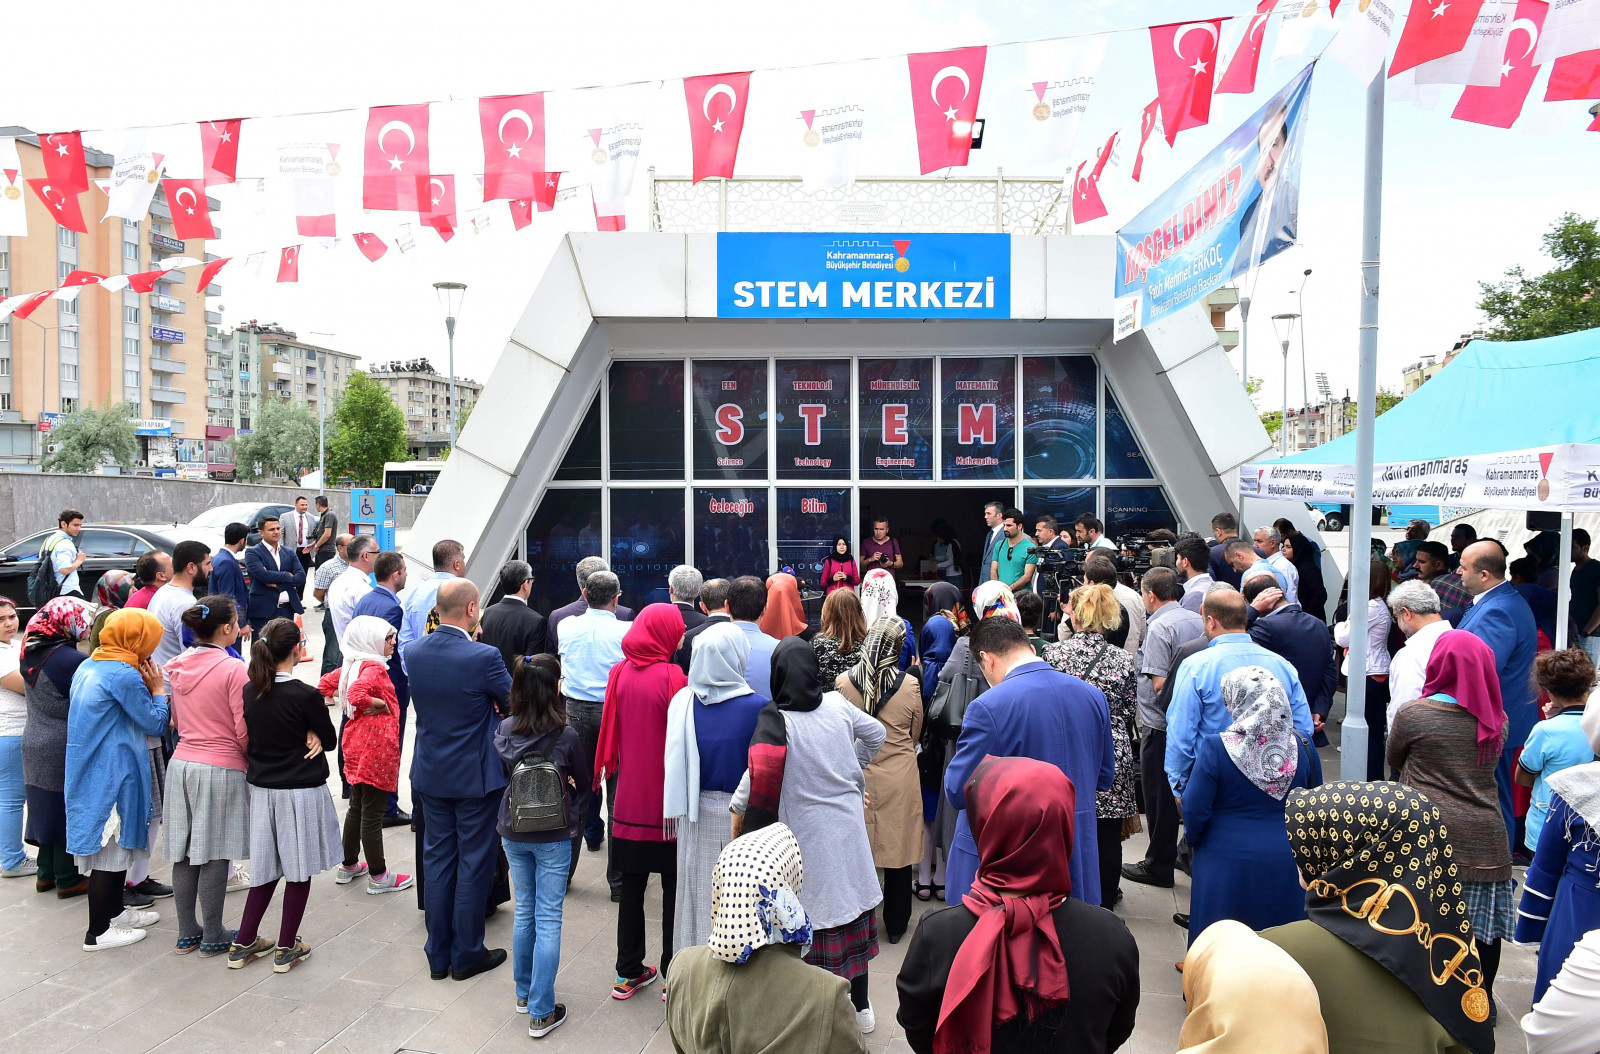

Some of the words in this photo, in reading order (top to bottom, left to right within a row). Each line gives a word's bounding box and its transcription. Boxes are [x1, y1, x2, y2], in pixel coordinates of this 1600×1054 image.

[826, 250, 894, 261] Kahramanmaraş
[1193, 242, 1224, 276] ERKOÇ
[826, 261, 861, 271] Büyükşehir
[862, 260, 894, 271] Belediyesi
[734, 281, 827, 308] STEM
[842, 276, 995, 308] MERKEZİ
[722, 380, 737, 390] FEN
[793, 379, 833, 391] TEKNOLOJİ
[870, 379, 920, 391] MÜHENDİSLİK
[956, 379, 999, 391] MATEMATİK
[715, 403, 744, 446] S
[798, 403, 827, 446] T
[881, 403, 909, 446] E
[957, 403, 997, 445] M
[717, 457, 743, 466] Science
[794, 457, 832, 467] Technology
[876, 456, 915, 467] Engineering
[956, 456, 998, 466] Mathematics
[1270, 466, 1323, 482] Kahramanmaraş
[1485, 469, 1539, 481] Kahramanmaraş
[1268, 484, 1291, 497] Büyükşehir
[1290, 484, 1315, 499] Belediyesi
[1417, 482, 1467, 501] Belediyesi
[1484, 486, 1511, 498] Büyükşehir
[1510, 486, 1537, 498] Belediyesi
[709, 498, 754, 517] Geleceğin
[801, 498, 827, 513] Bilim
